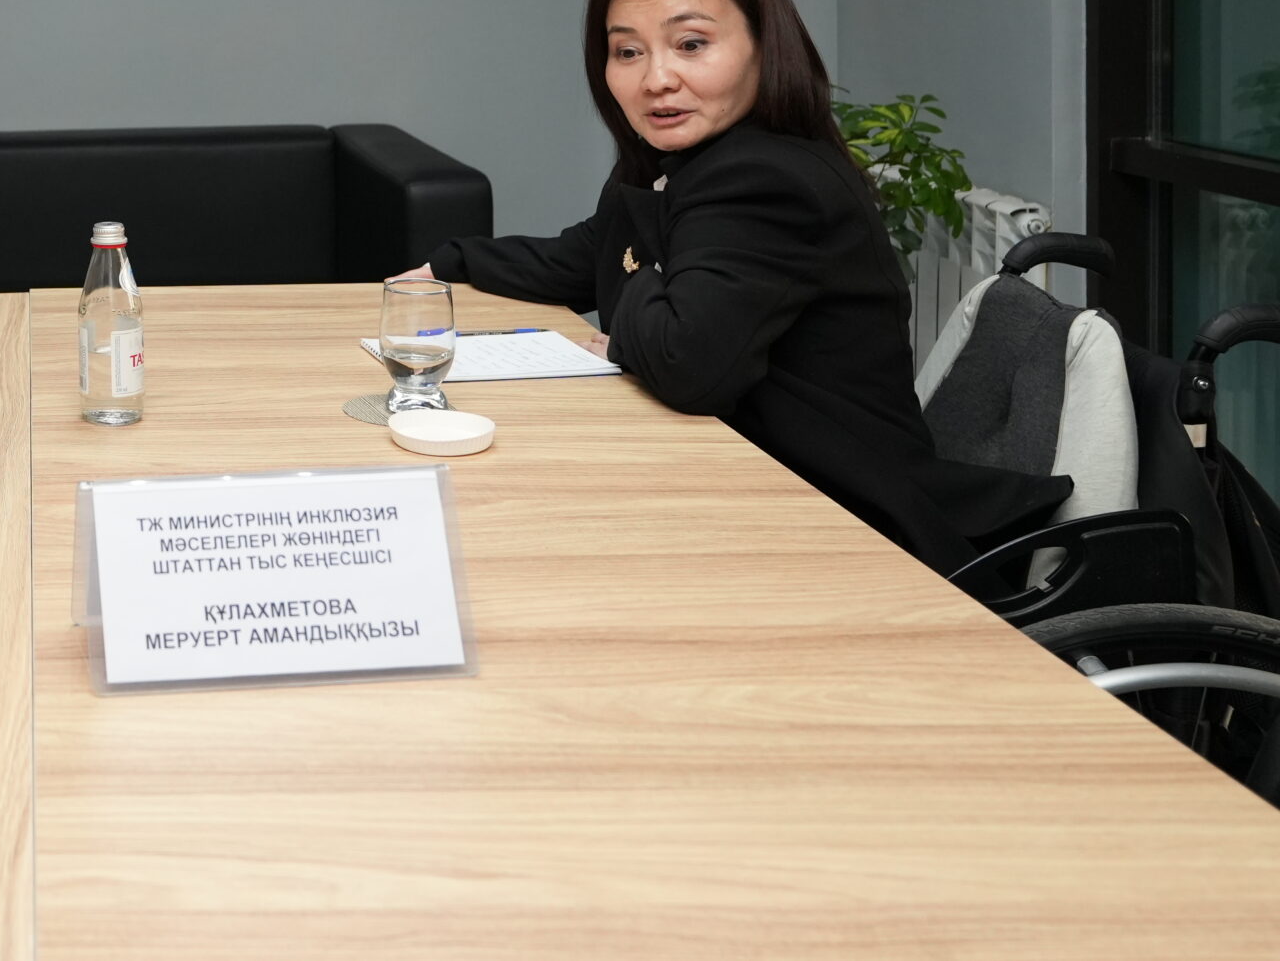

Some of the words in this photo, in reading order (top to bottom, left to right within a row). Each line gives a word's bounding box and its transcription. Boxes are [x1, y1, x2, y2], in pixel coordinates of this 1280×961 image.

[136, 517, 163, 532] ТЖ
[169, 511, 293, 531] МИНИСТРІНІҢ
[297, 506, 399, 525] ИНКЛЮЗИЯ
[160, 532, 277, 553] МӘСЕЛЕЛЕРІ
[282, 527, 381, 547] ЖӨНІНДЕГІ
[152, 556, 242, 575] ШТАТТАН
[247, 553, 288, 570] ТЫС
[293, 549, 393, 570] КЕҢЕСШІСІ
[204, 597, 358, 624] ҚҰЛАХМЕТОВА
[145, 629, 242, 650] МЕРУЕРТ
[249, 619, 421, 645] АМАНДЫҚҚЫЗЫ
